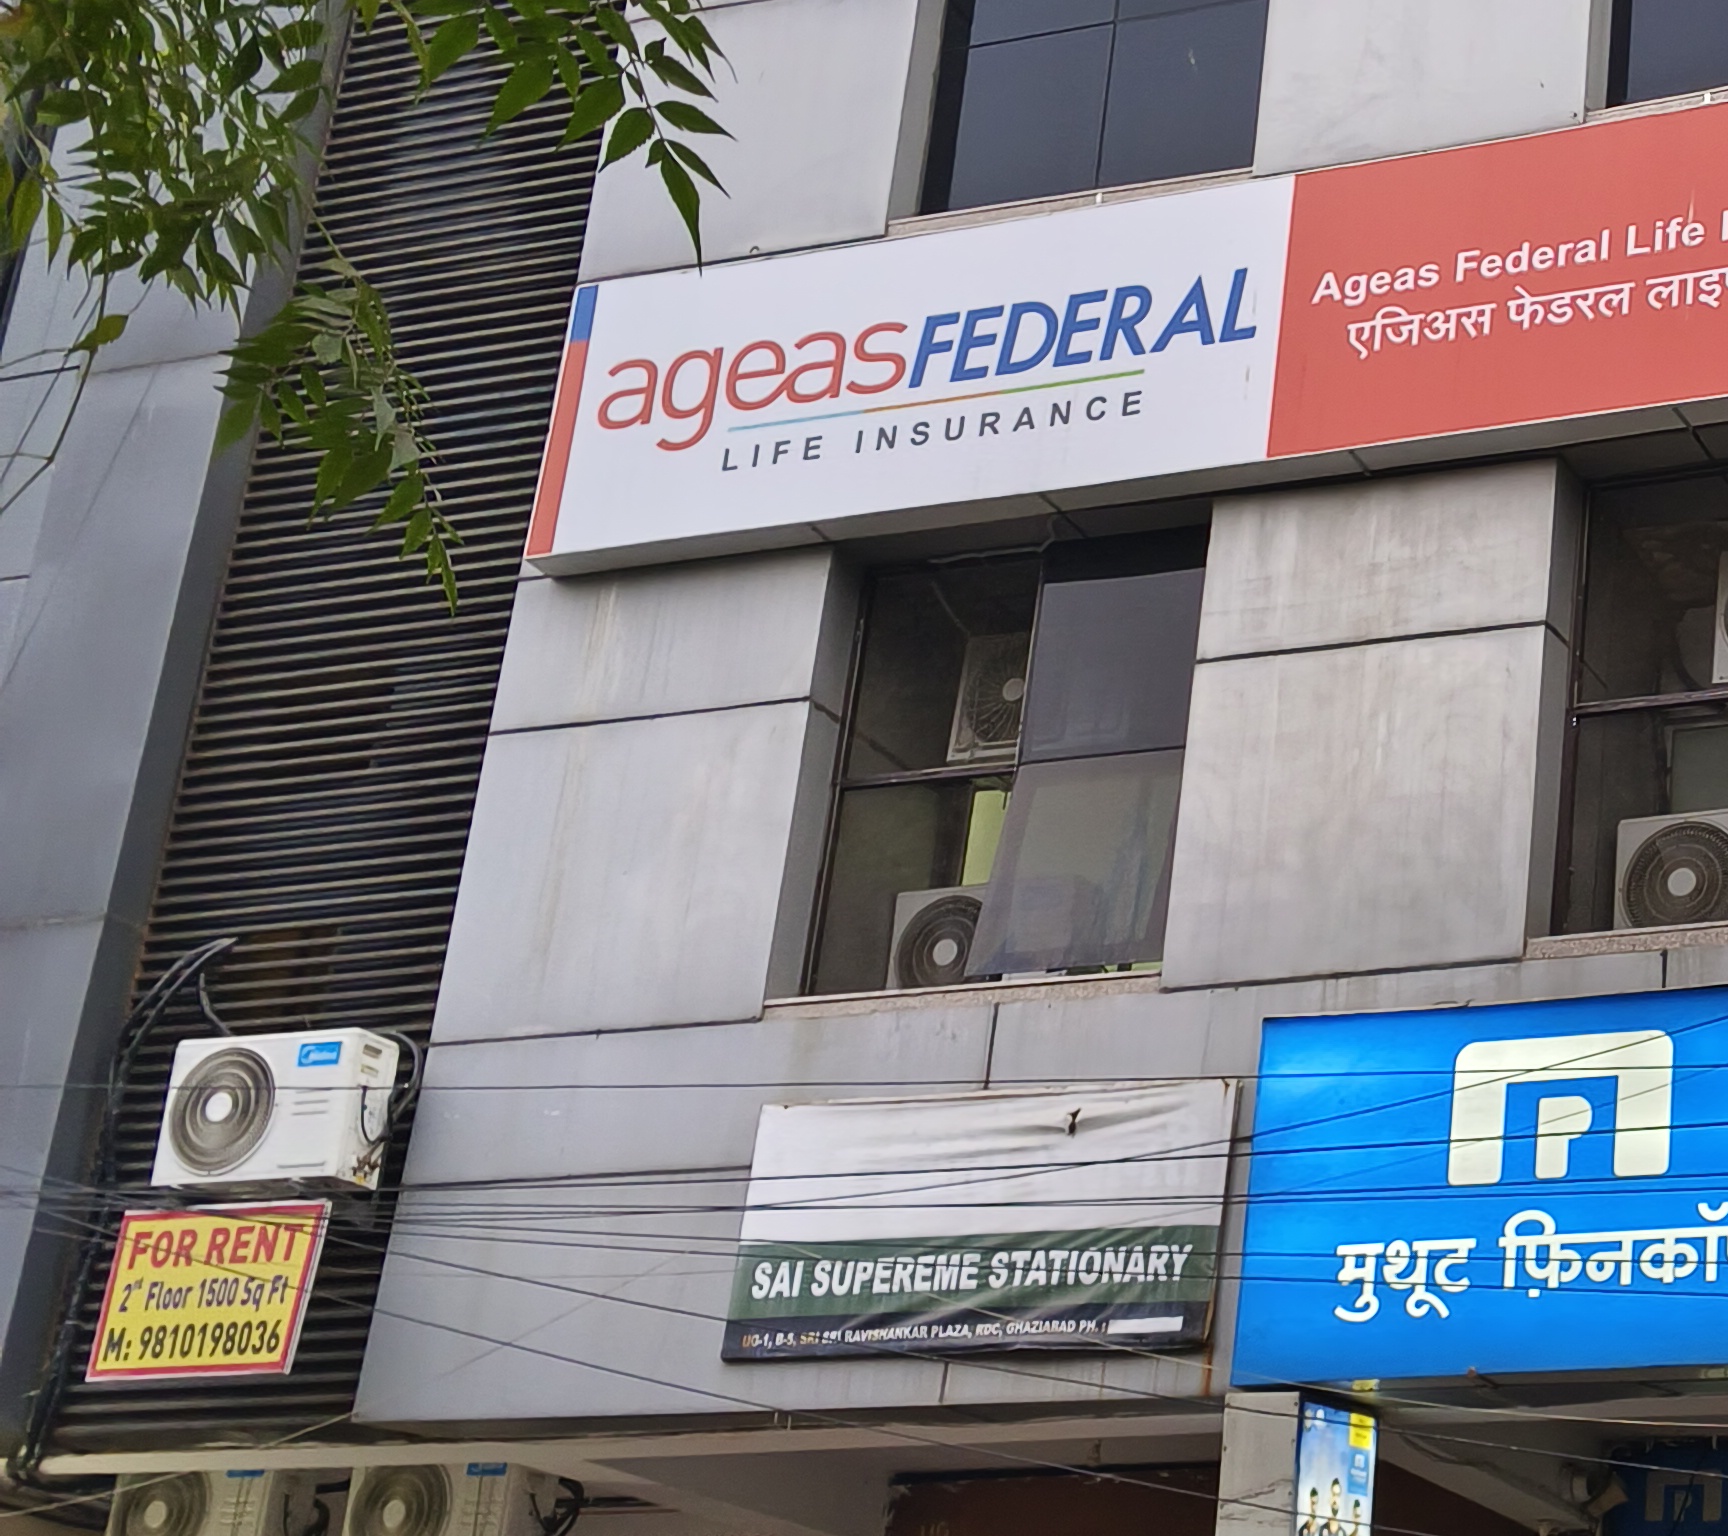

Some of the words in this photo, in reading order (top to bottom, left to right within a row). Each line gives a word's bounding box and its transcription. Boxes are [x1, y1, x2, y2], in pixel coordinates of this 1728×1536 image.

[1310, 261, 1441, 310] Ageas
[1455, 227, 1611, 284] Federal
[1627, 210, 1706, 261] Life
[1346, 297, 1493, 362] एजिअस
[1506, 275, 1632, 334] फेडरल
[719, 433, 823, 473] LIFE
[854, 390, 1145, 455] INSURANCE
[127, 1228, 197, 1270] FOR
[203, 1222, 302, 1267] RENT
[751, 1260, 803, 1301] SAI
[810, 1253, 981, 1298] SUPEREME
[988, 1244, 1194, 1289] STATIONARY
[1333, 1234, 1477, 1325] मुथूट
[144, 1280, 193, 1312] Floor
[198, 1277, 239, 1309] 1500
[239, 1276, 264, 1311] Sq
[268, 1273, 289, 1305] Ft
[102, 1326, 133, 1363] M:
[137, 1319, 282, 1361] 9810198036
